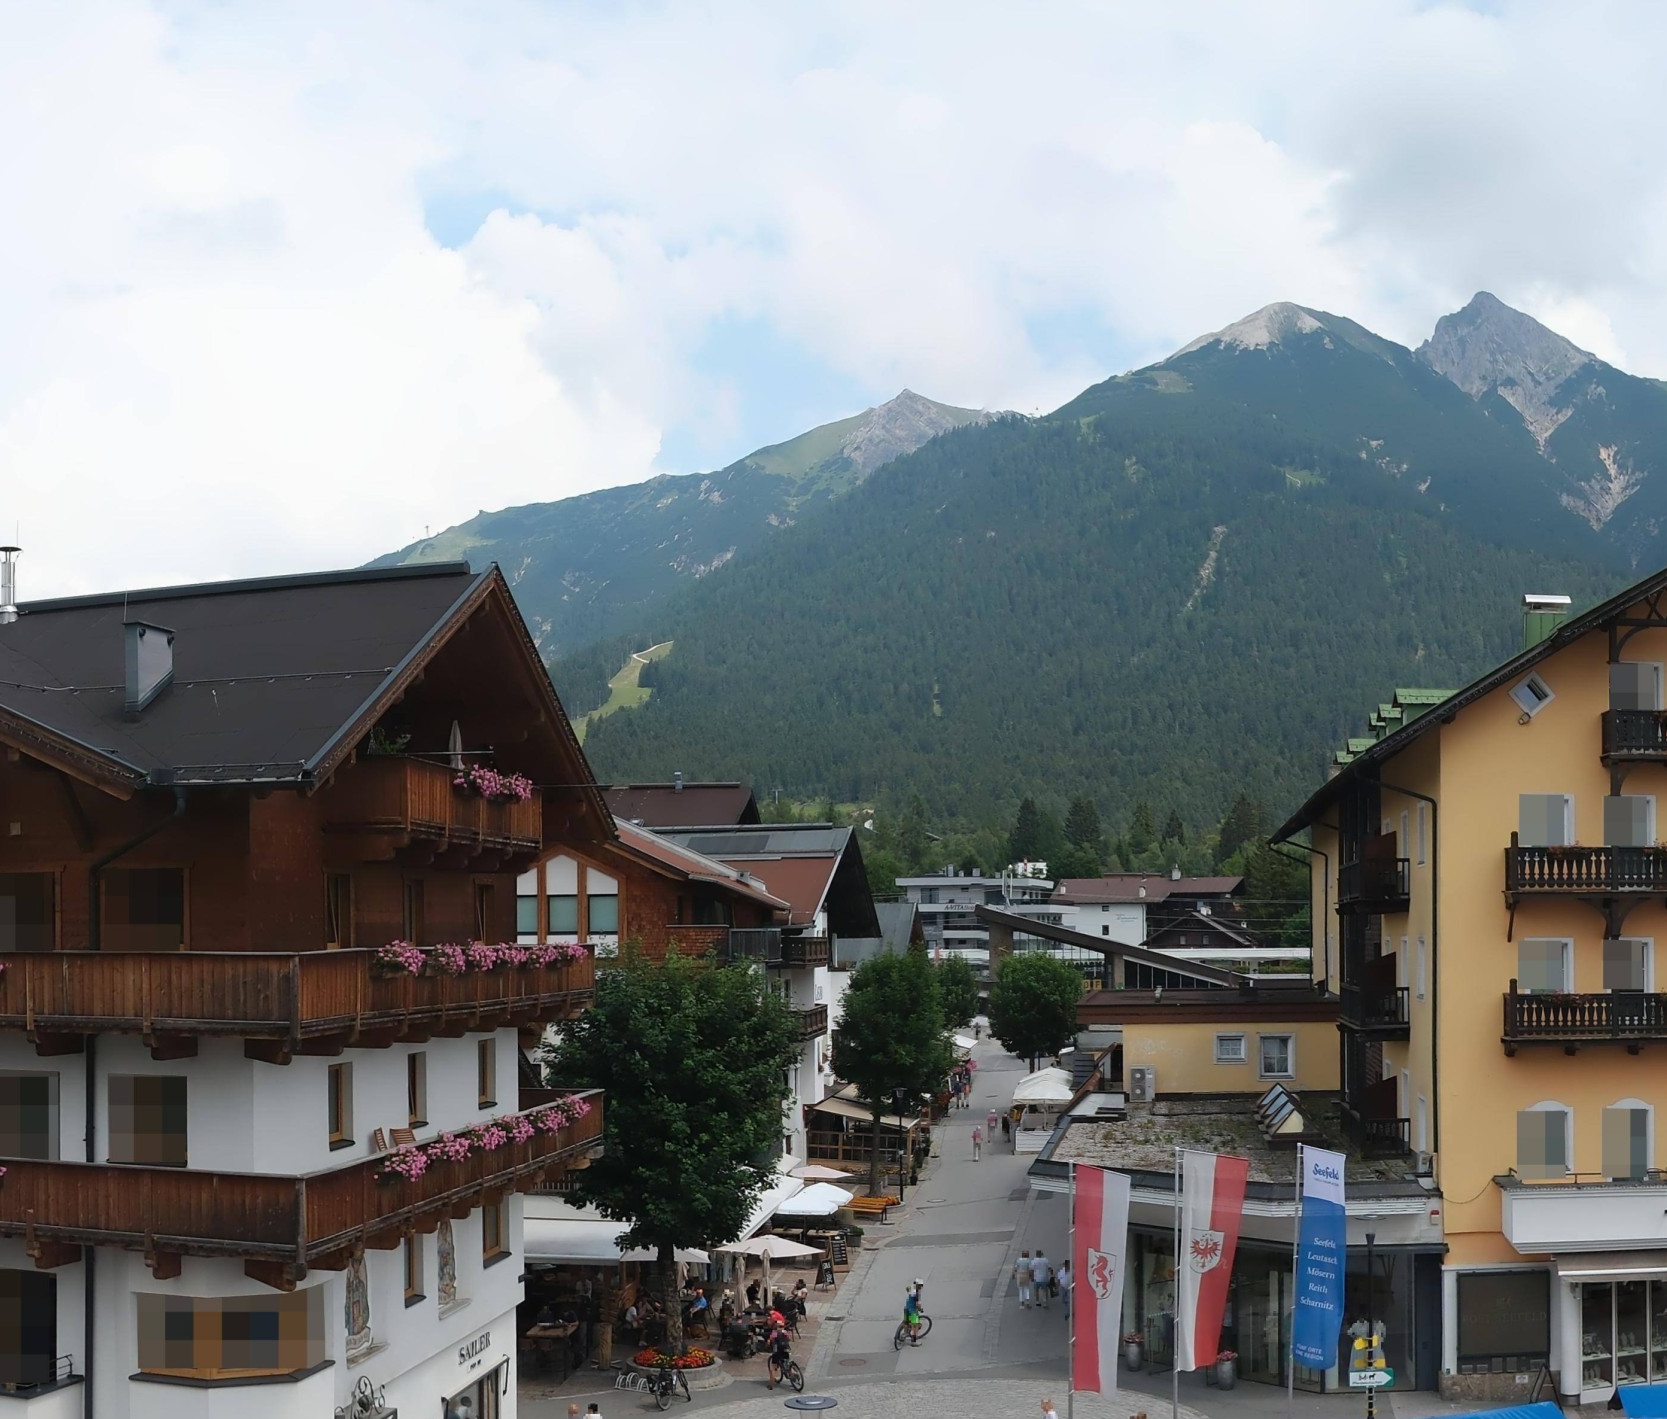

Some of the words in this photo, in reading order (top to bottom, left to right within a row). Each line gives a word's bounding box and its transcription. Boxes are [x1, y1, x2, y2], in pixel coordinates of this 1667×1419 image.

[1306, 1267, 1335, 1279] Mösern
[1308, 1283, 1328, 1294] Reith
[1300, 1296, 1334, 1311] Scharnitz
[458, 1332, 491, 1365] SAILER
